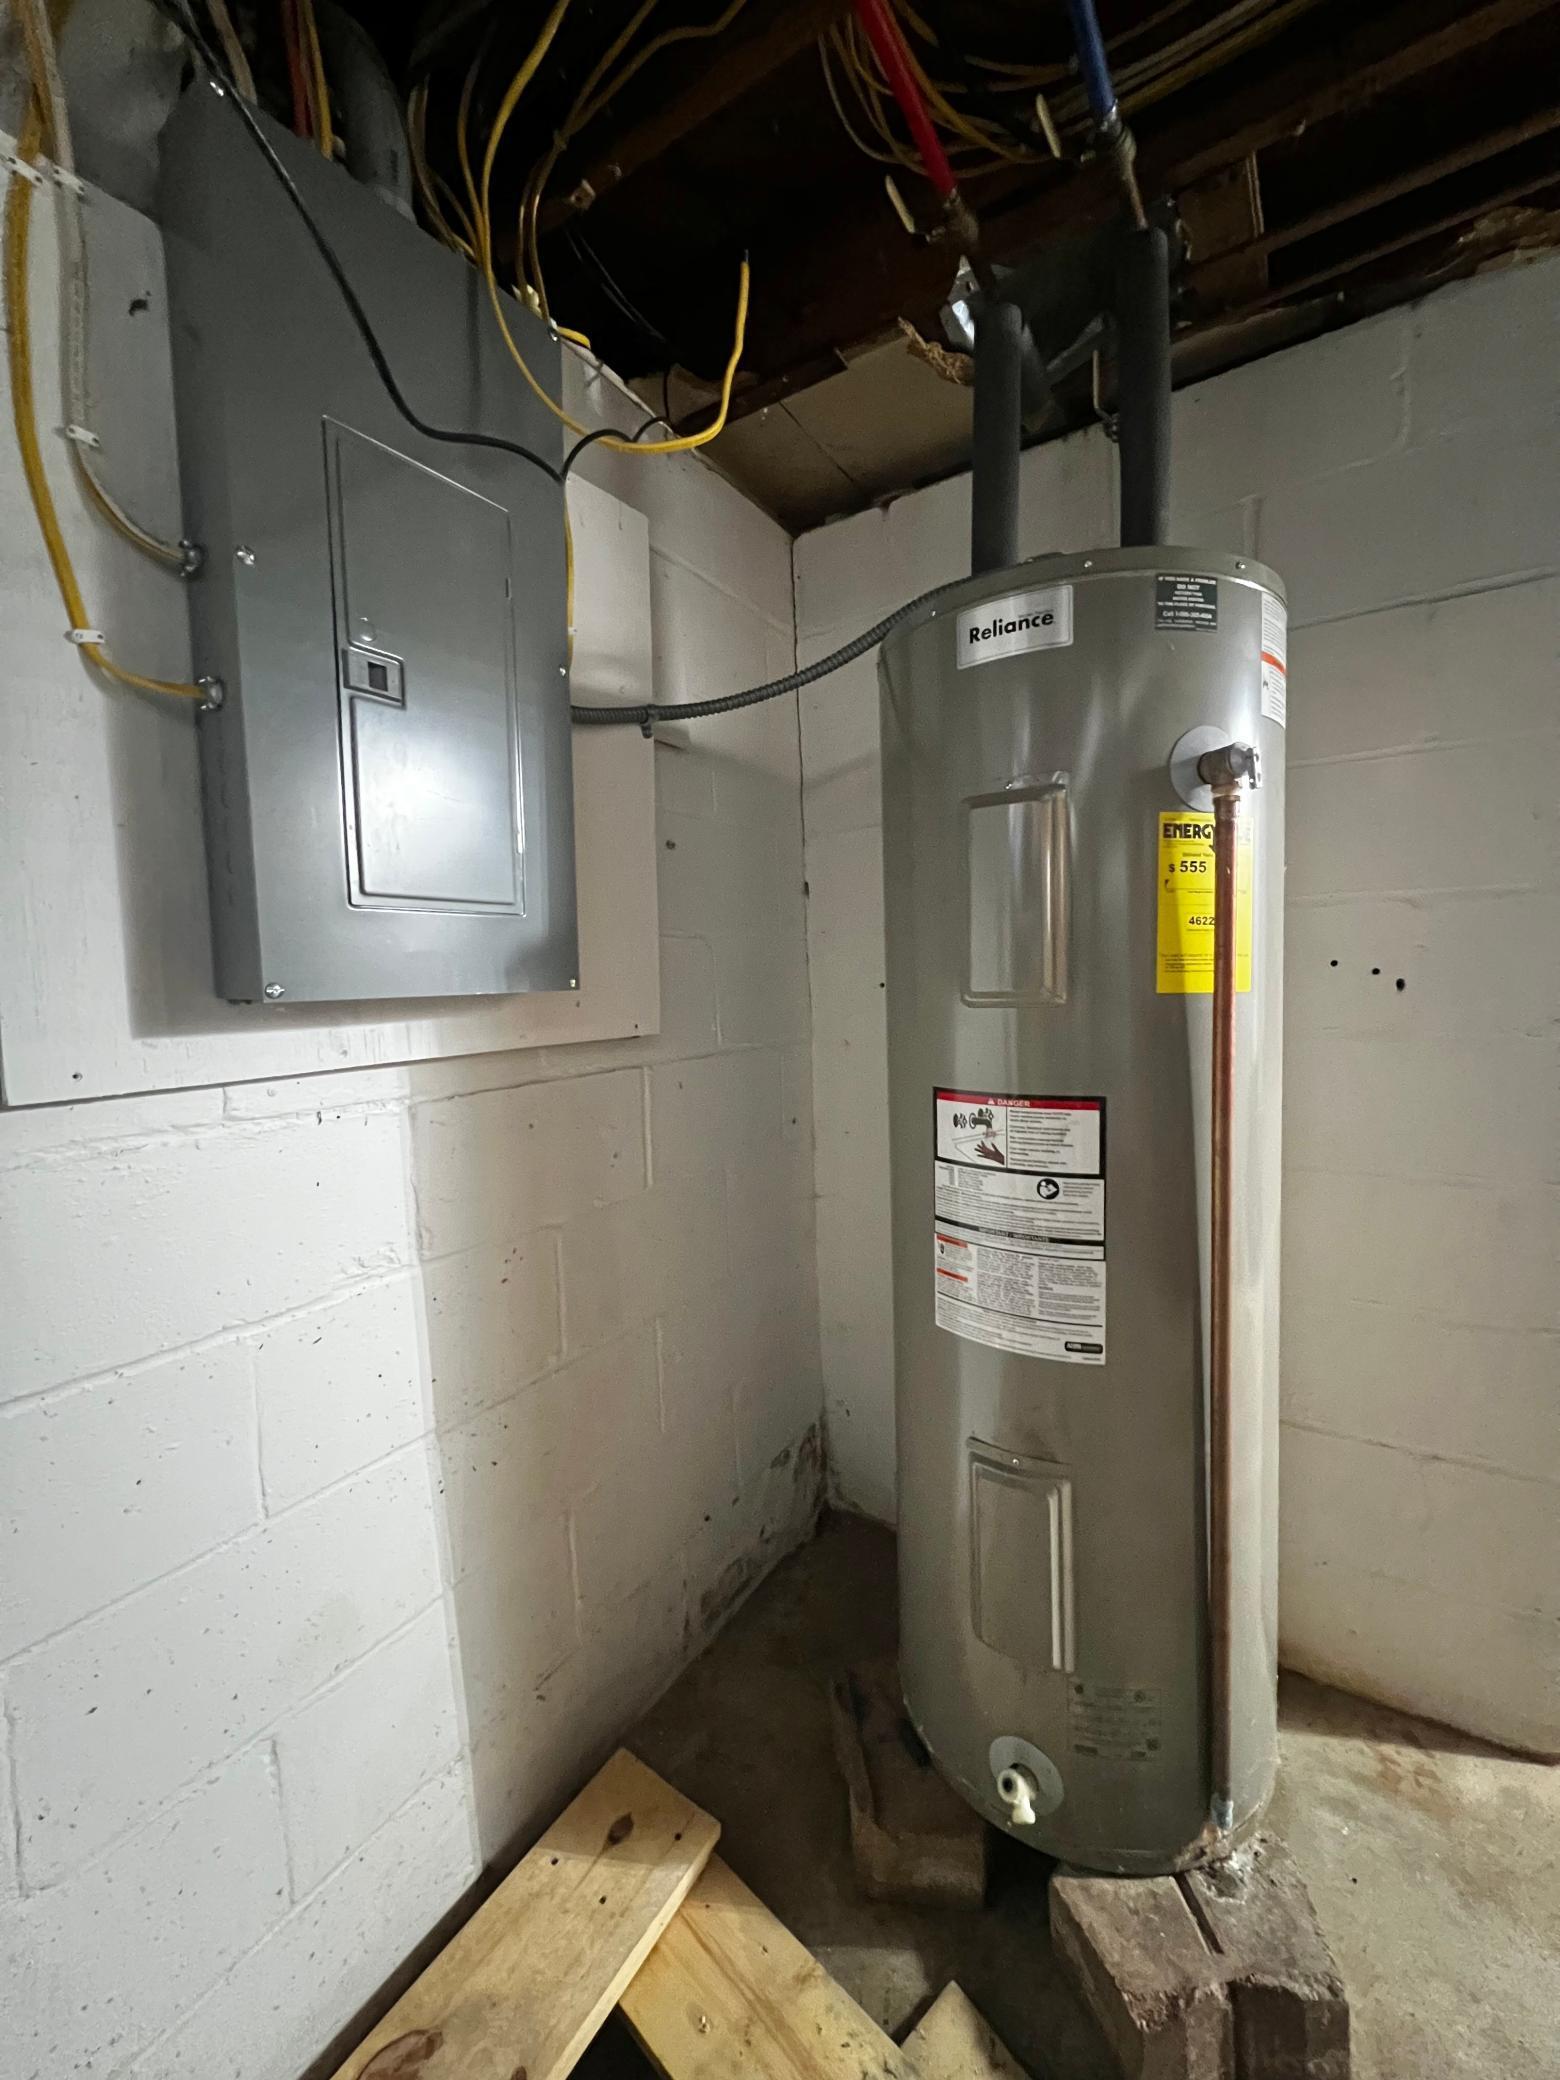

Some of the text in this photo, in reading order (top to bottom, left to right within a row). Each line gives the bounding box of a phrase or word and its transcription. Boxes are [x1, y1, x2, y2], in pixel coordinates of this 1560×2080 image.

[969, 613, 1055, 644] Reliance
[1180, 860, 1207, 873] 555
[1188, 916, 1216, 926] 4622
[997, 1099, 1031, 1108] DANGER
